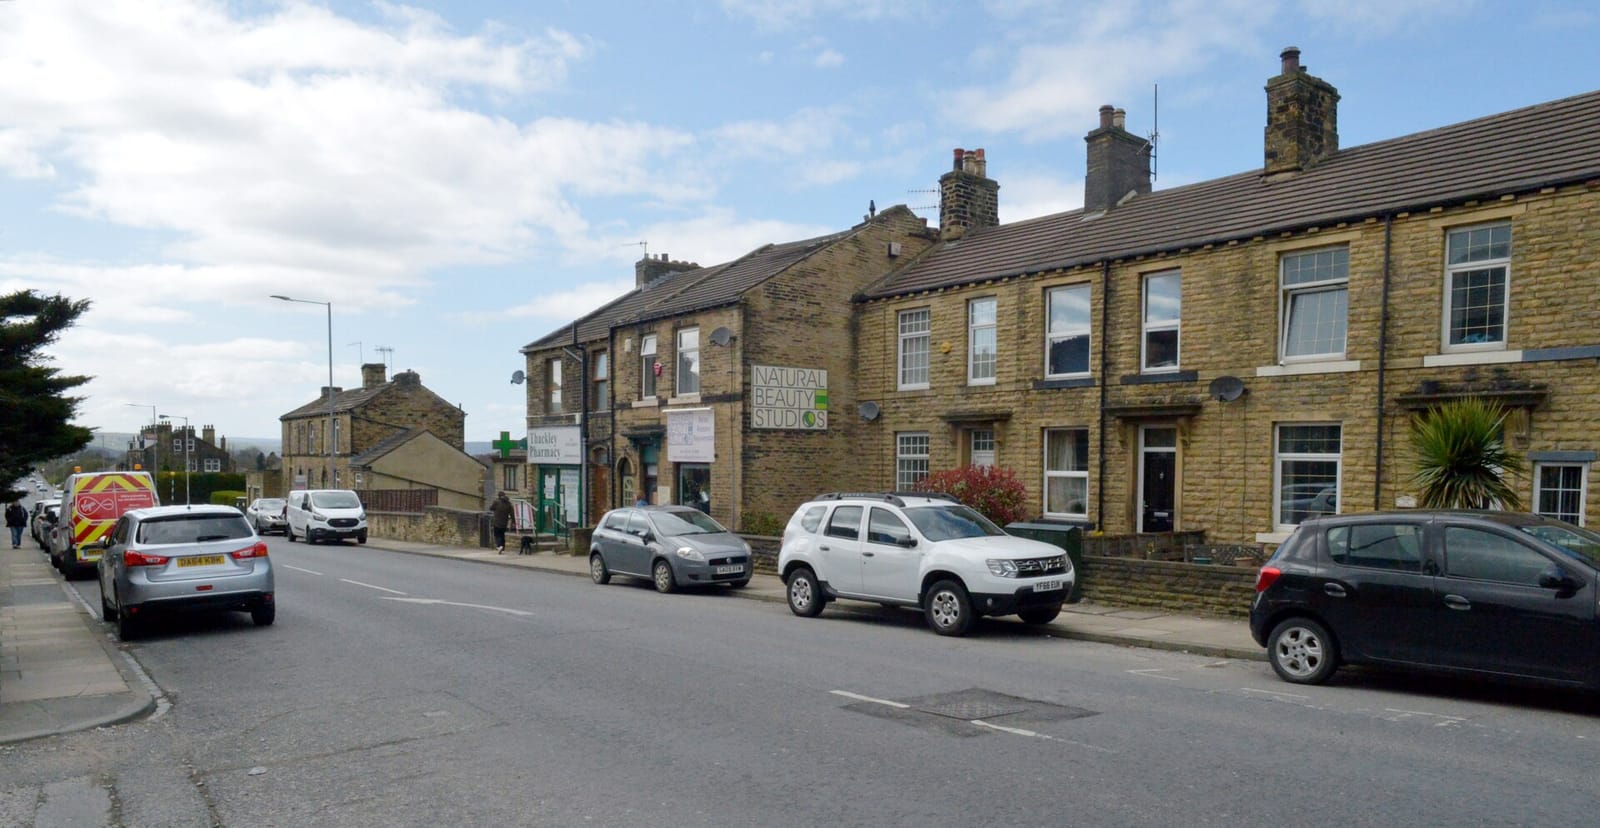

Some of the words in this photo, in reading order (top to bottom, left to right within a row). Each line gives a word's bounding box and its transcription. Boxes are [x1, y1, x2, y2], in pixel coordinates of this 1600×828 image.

[755, 367, 825, 388] NATURAL
[755, 387, 814, 407] BEAUTY
[755, 409, 825, 428] STUDIOS
[530, 432, 558, 447] Thackley
[529, 446, 561, 460] Pharmacy
